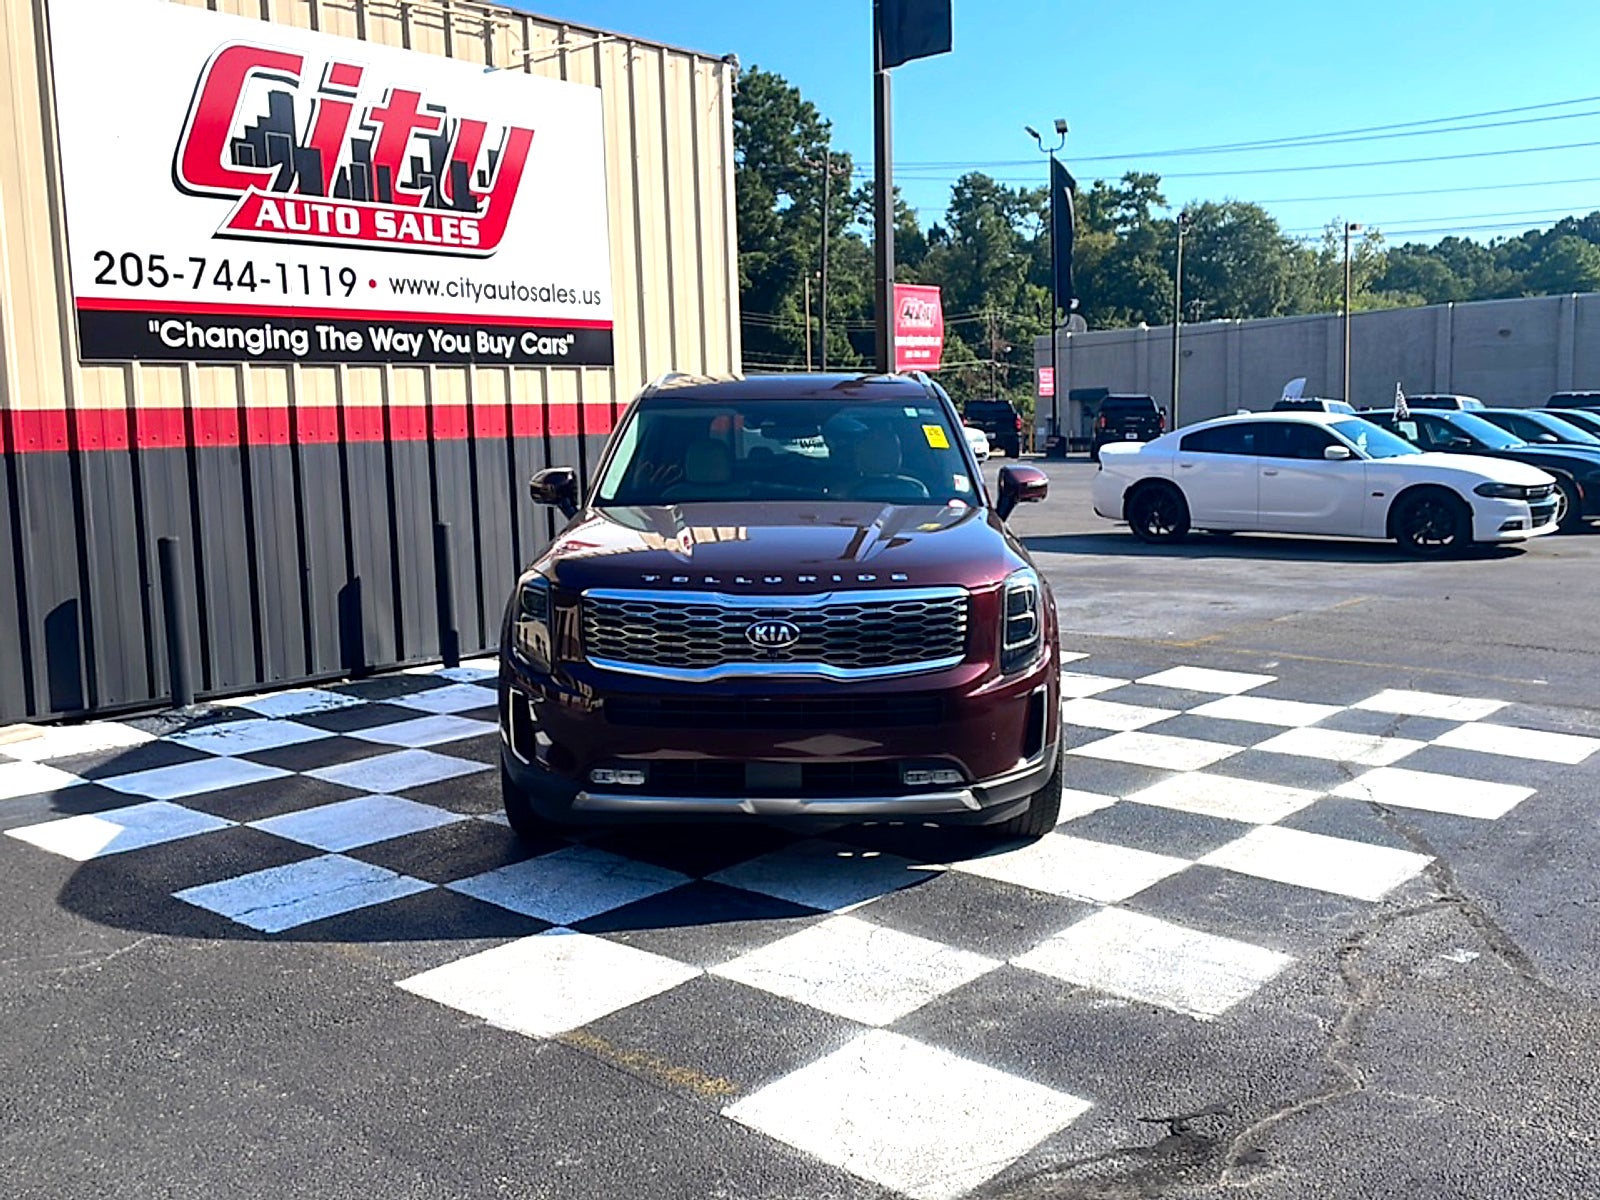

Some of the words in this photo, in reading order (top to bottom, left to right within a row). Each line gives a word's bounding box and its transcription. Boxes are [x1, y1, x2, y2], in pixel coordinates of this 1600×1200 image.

[176, 42, 535, 254] City
[255, 199, 361, 235] AUTO
[374, 210, 480, 246] SALES
[93, 249, 357, 297] 205-744-1119
[389, 276, 602, 306] www.cityautosales.us
[148, 319, 309, 356] "Changing
[315, 325, 363, 351] The
[368, 326, 423, 358] Way
[427, 328, 470, 354] You
[476, 330, 516, 359] Buy
[520, 331, 575, 355] Cars"
[641, 573, 909, 584] TELLURIDE
[754, 626, 793, 642] KIA
